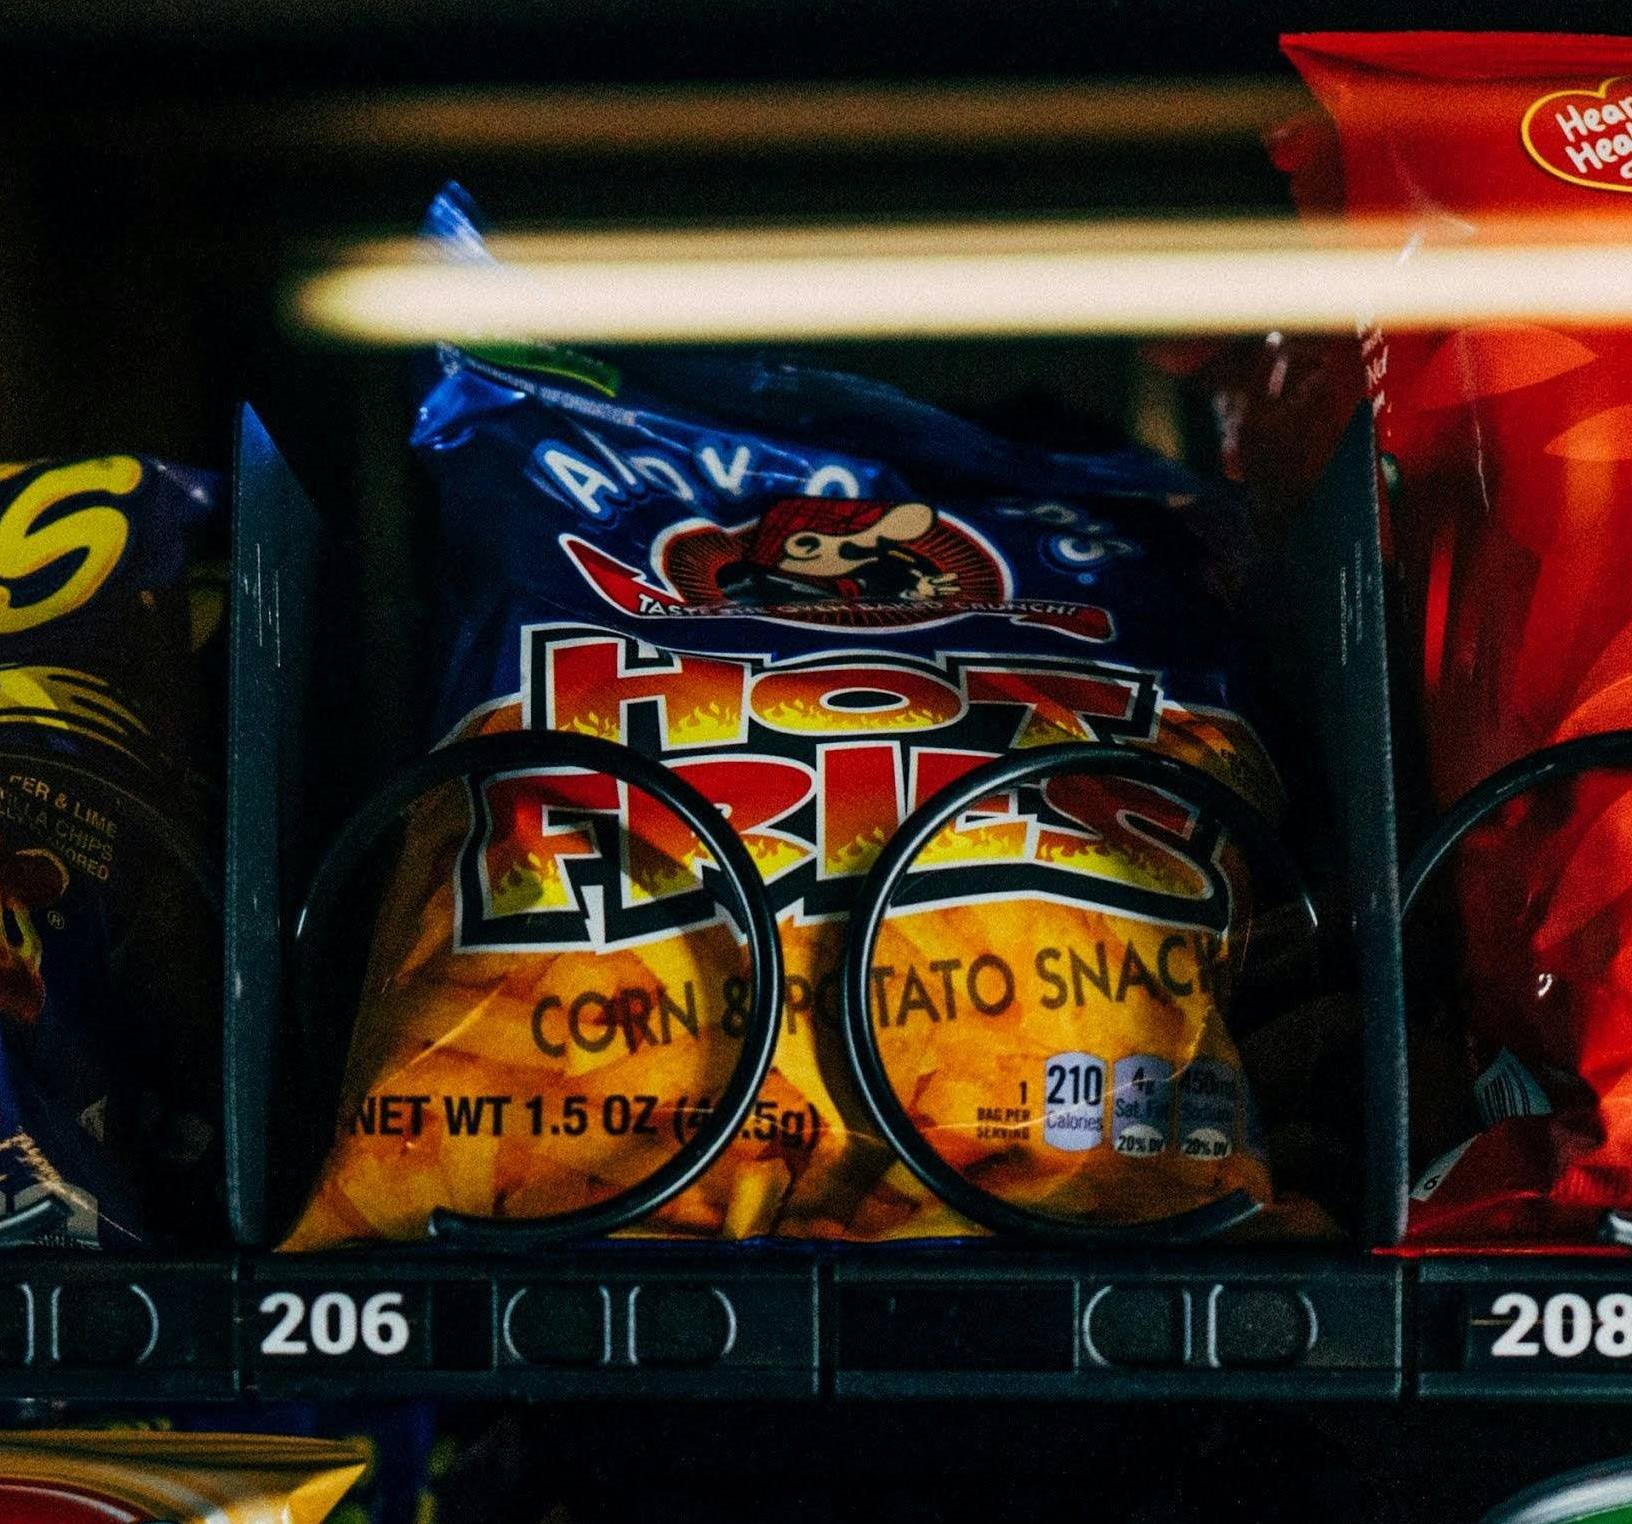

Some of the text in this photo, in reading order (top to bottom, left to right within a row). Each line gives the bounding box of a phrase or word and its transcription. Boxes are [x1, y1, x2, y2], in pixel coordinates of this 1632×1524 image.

[535, 630, 1152, 750] HOT
[472, 742, 1222, 922] FRIES
[531, 979, 701, 1058] CORN
[723, 975, 751, 1038] &
[1046, 1064, 1103, 1106] 210
[349, 1095, 658, 1138] NET WT 1.5 OZ
[1007, 1107, 1031, 1122] PER
[1046, 1111, 1104, 1132] Calories
[258, 1290, 410, 1356] 206
